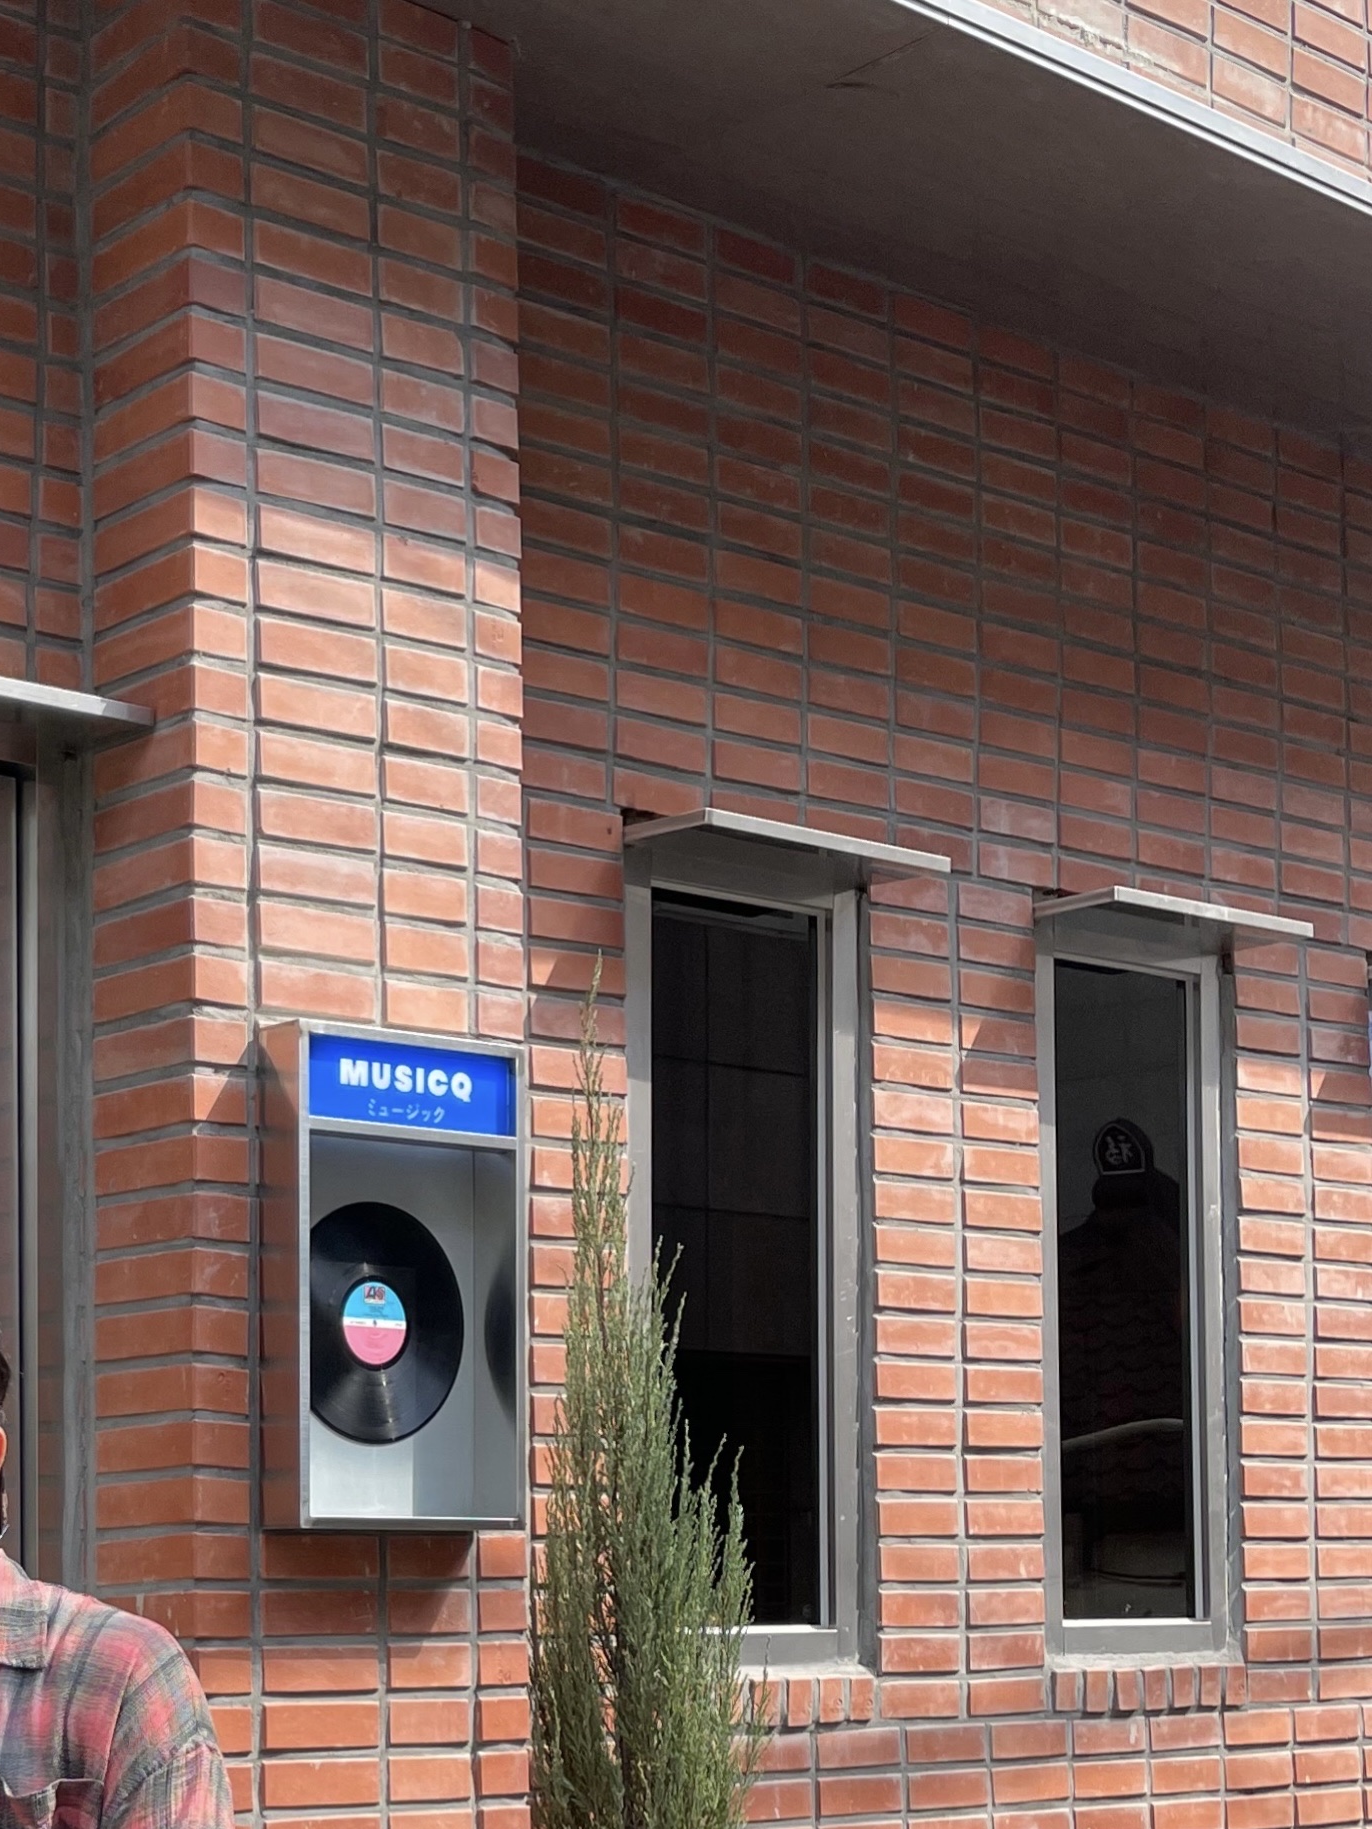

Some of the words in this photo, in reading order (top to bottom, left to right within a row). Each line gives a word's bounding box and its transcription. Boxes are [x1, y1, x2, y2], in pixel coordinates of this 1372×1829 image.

[339, 1058, 473, 1102] MUSICQ
[368, 1098, 445, 1124] ミュージック
